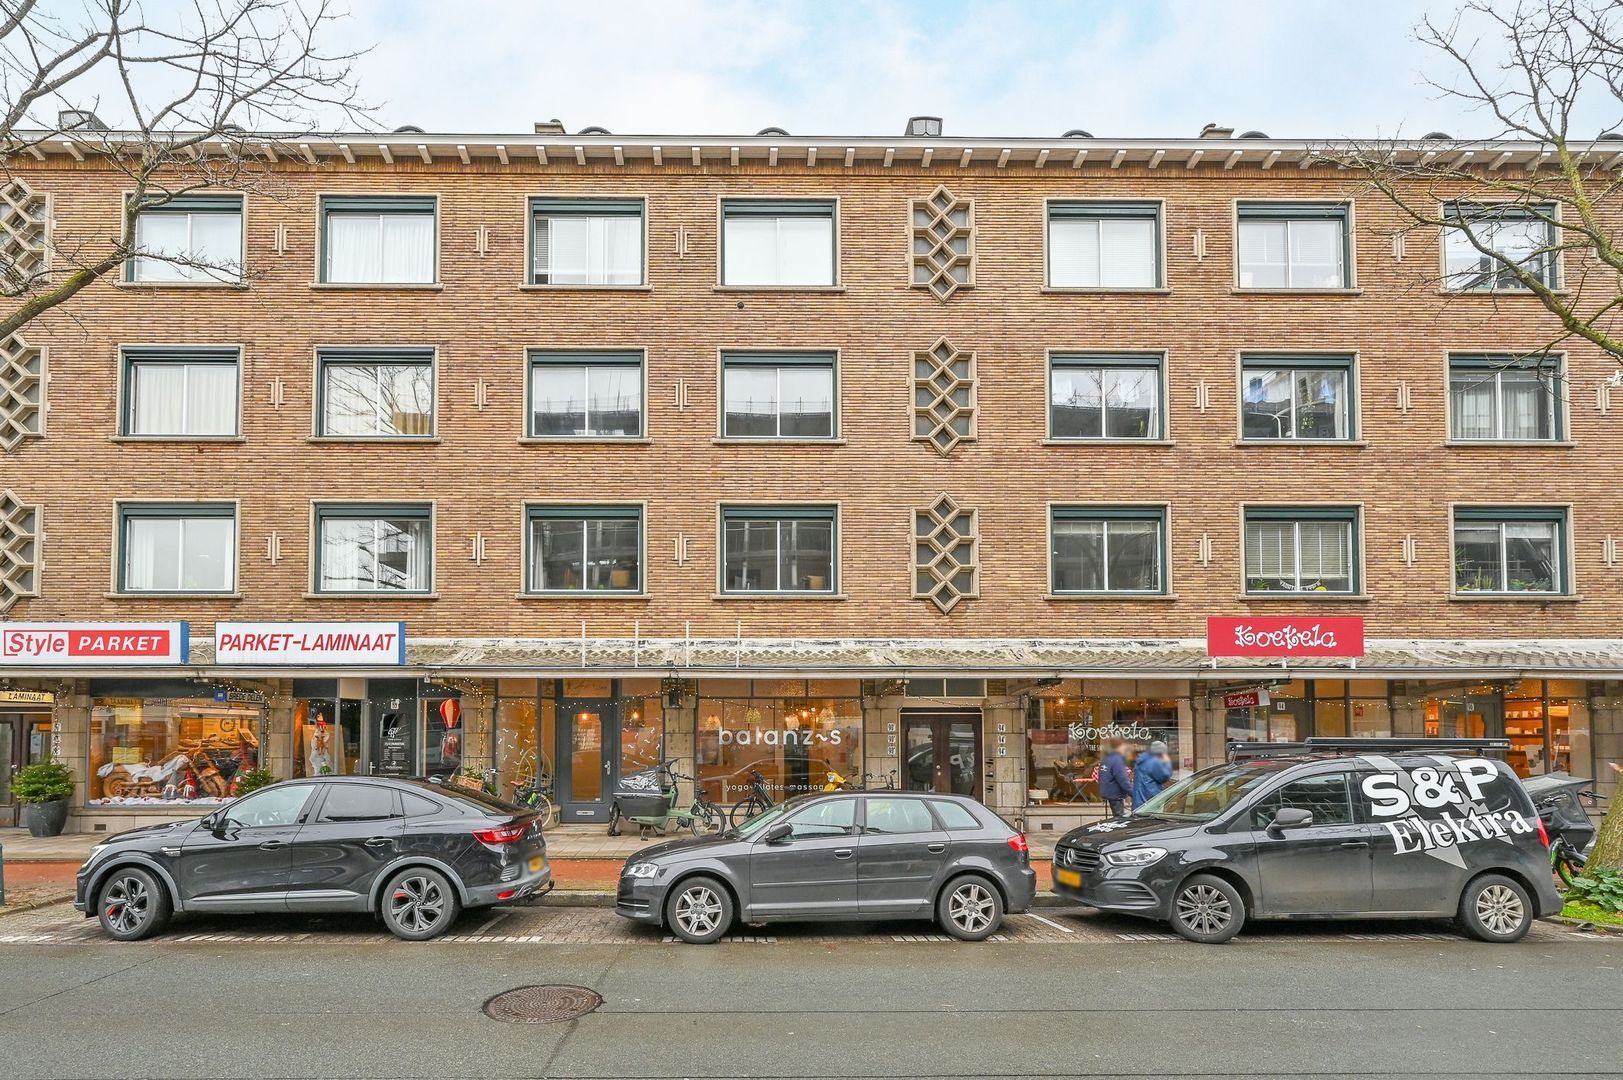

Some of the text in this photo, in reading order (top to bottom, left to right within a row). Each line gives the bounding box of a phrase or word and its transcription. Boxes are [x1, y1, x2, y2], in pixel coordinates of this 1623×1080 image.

[9, 633, 162, 656] Style PARKET
[219, 633, 396, 651] PARKET-LAMINAAT
[1234, 624, 1337, 649] Koekela
[8, 693, 46, 701] LAMINAAT
[1068, 721, 1152, 740] Koekela
[1361, 758, 1499, 816] S&P
[1381, 809, 1534, 856] Elektra
